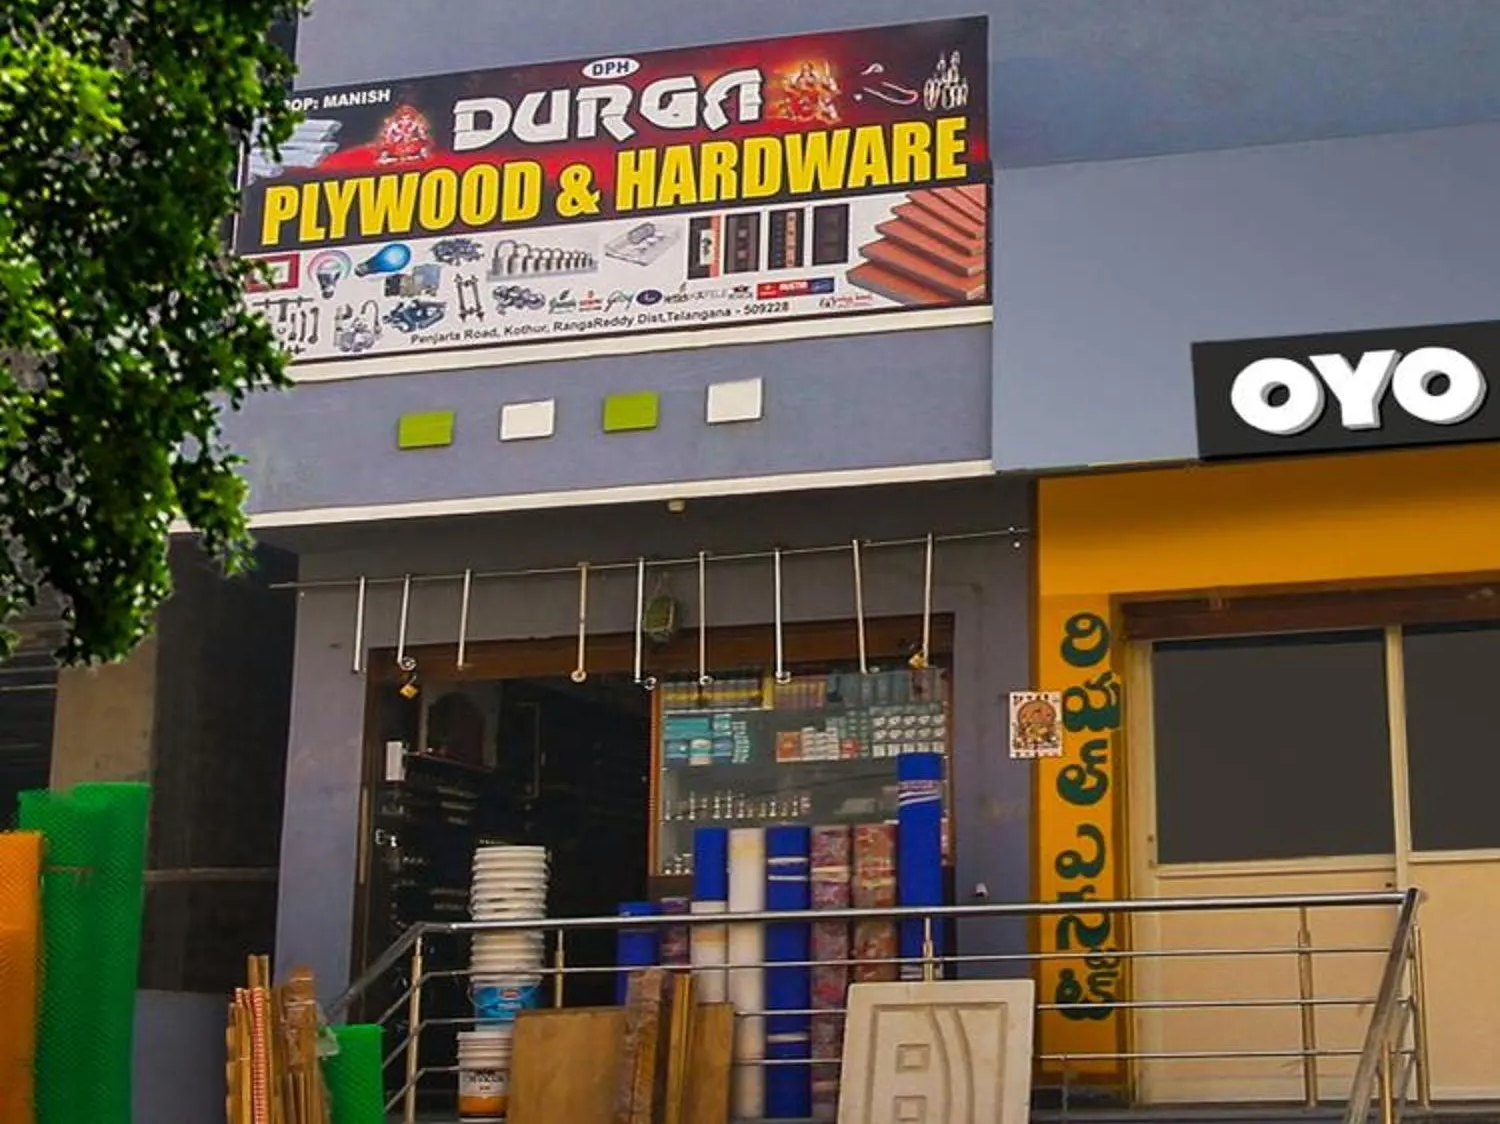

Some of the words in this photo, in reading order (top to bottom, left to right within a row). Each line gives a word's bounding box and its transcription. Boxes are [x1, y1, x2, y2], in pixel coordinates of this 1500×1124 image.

[323, 88, 391, 109] MANISH
[452, 67, 764, 152] DURGA
[592, 60, 630, 76] DPH
[261, 160, 542, 246] PLYWOOD
[555, 163, 601, 217] &
[615, 116, 967, 212] HARDWARE
[1230, 346, 1487, 436] OYO
